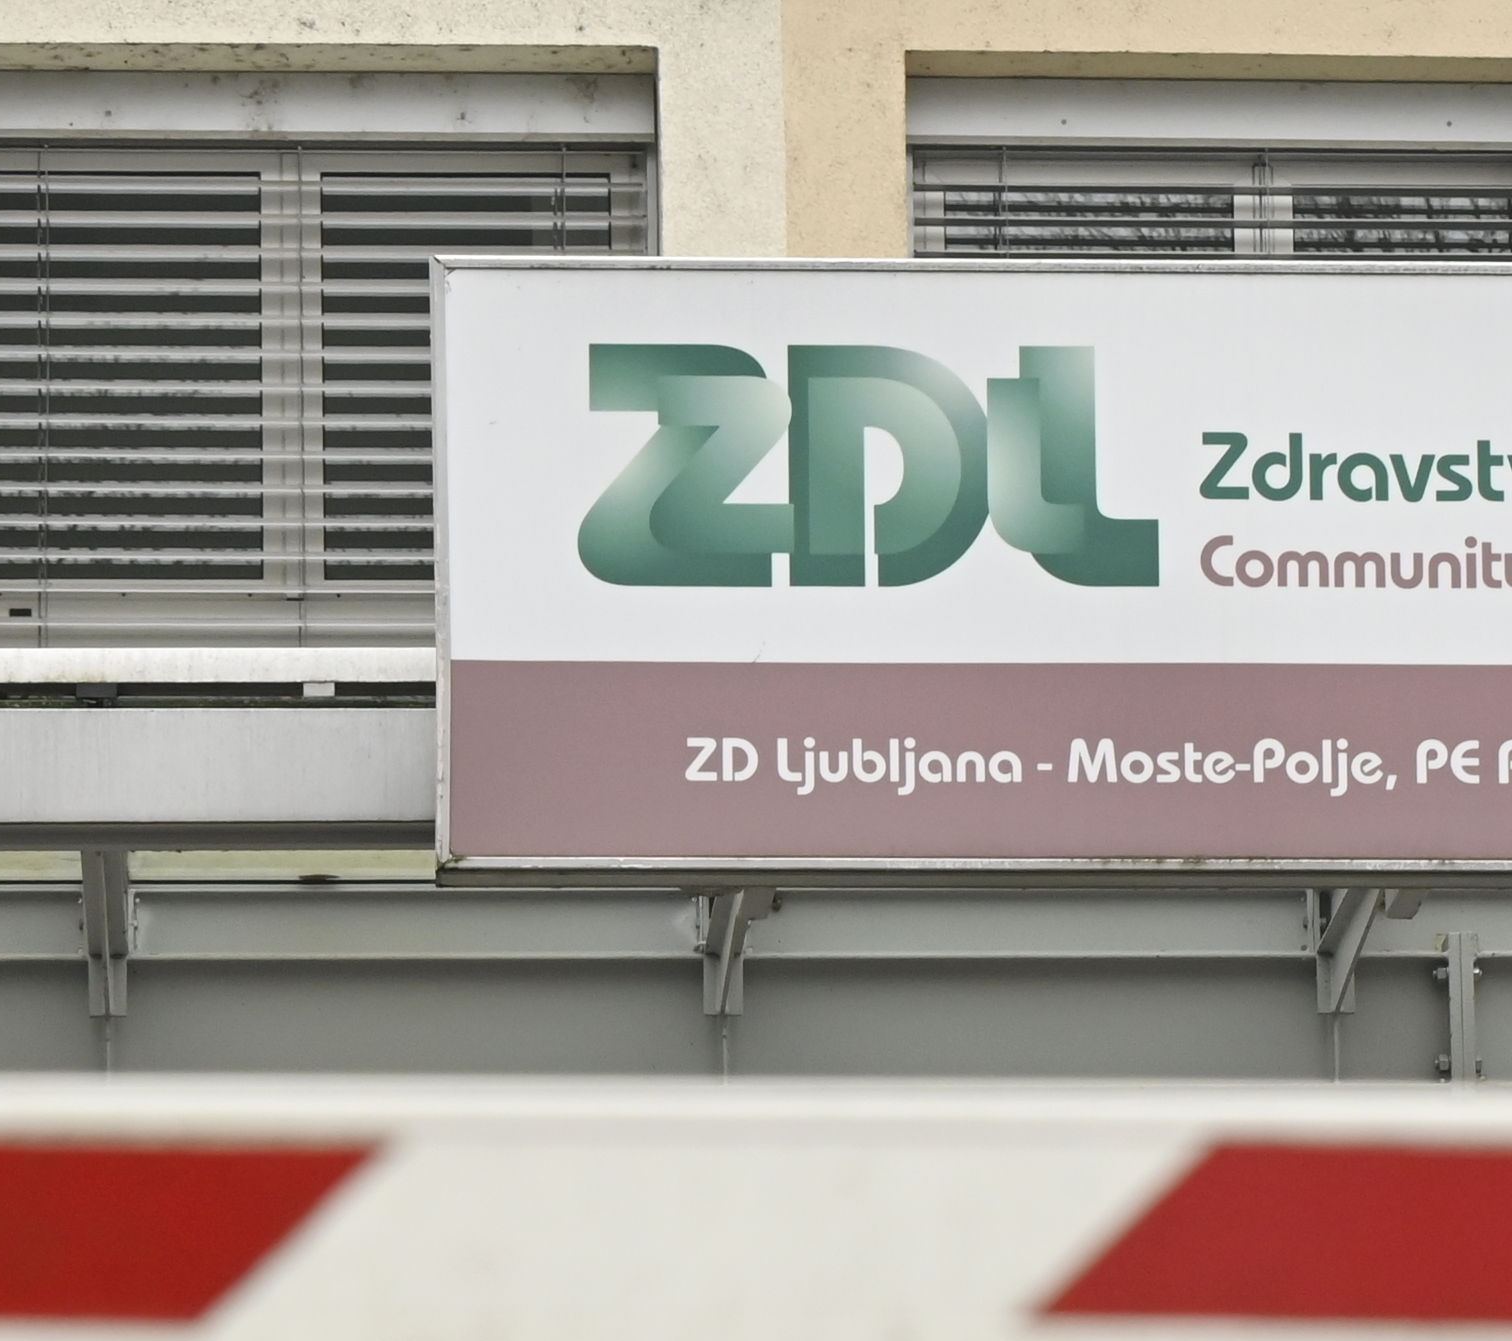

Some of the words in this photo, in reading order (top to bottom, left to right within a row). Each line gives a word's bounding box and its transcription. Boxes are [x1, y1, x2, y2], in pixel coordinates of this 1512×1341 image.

[684, 738, 759, 782] ZD
[776, 737, 1023, 796] Ljubljana
[1036, 763, 1053, 771] -
[1067, 738, 1397, 797] Moste-Polje,
[1416, 738, 1480, 784] PE
